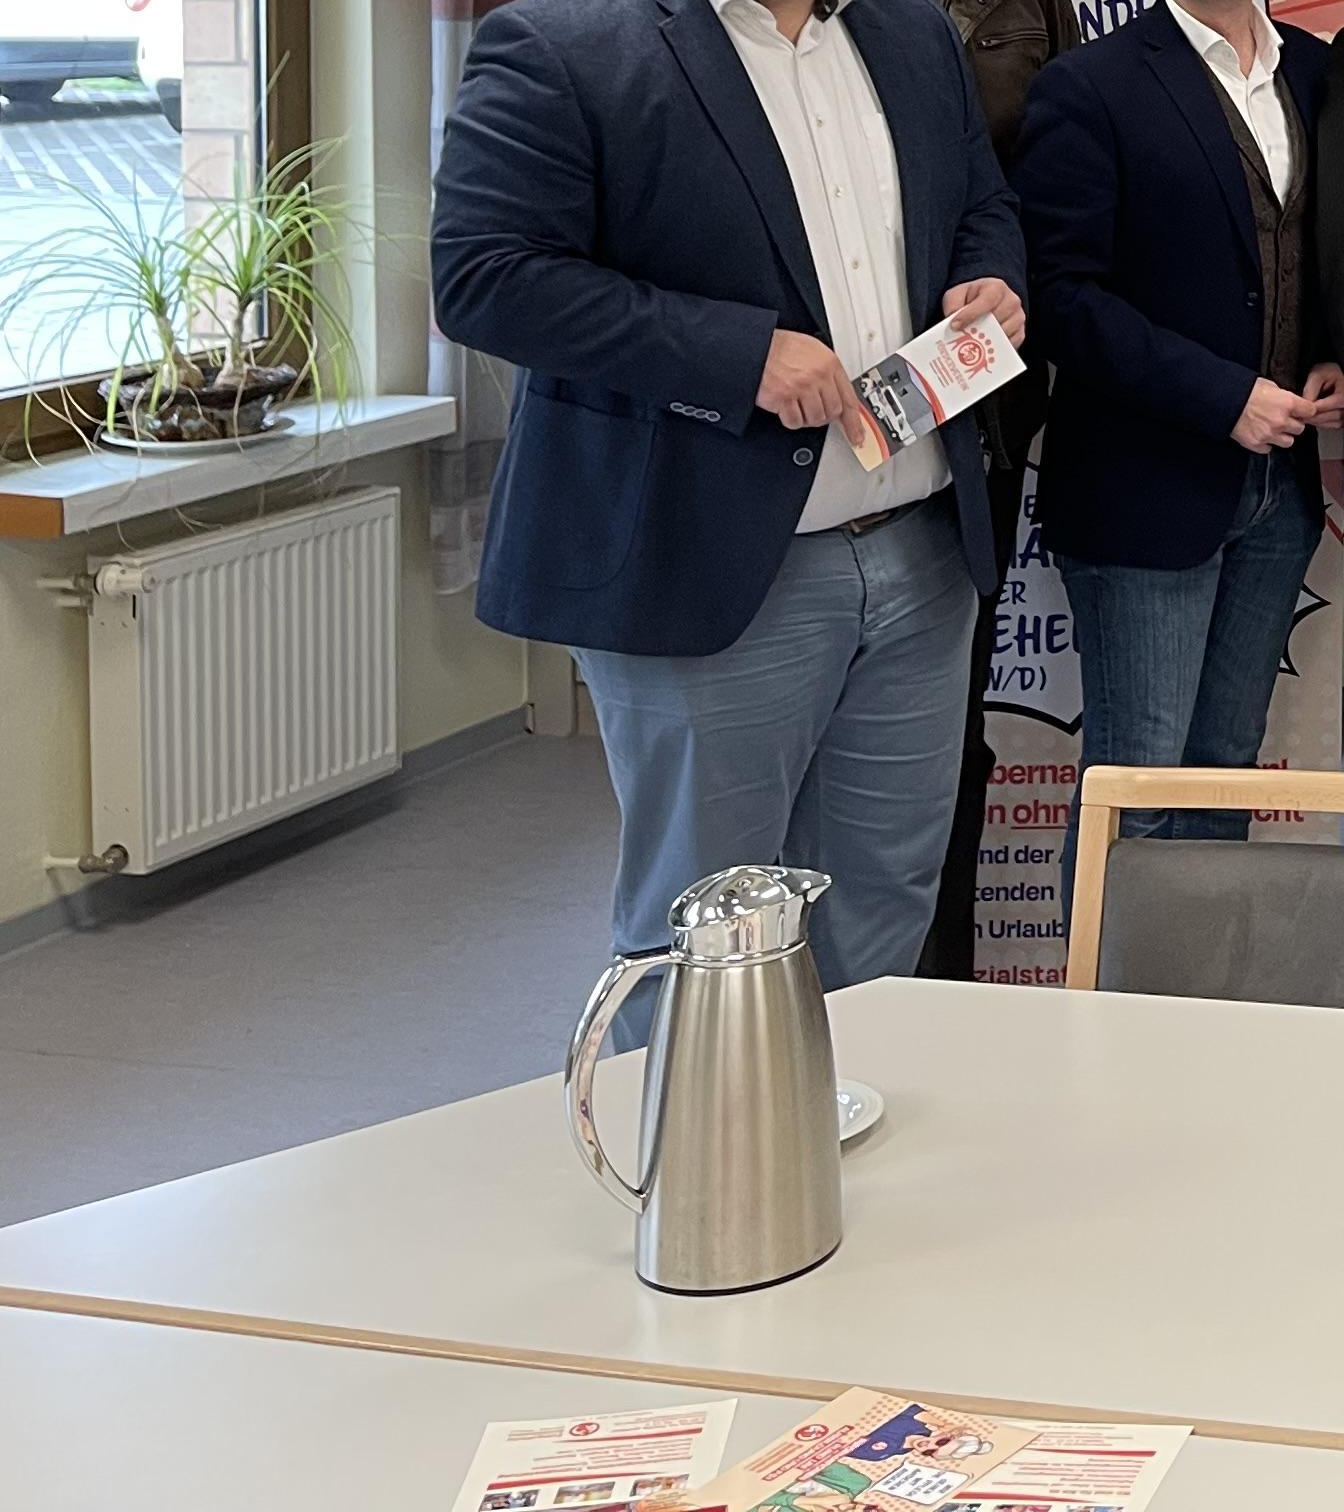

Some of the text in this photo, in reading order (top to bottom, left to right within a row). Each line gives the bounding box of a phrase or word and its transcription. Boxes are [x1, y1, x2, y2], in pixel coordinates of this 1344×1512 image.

[988, 763, 1077, 786] berna
[1011, 799, 1070, 826] ohn
[979, 845, 1009, 864] nd
[1014, 846, 1055, 864] der
[988, 919, 1064, 939] Urlaub
[974, 965, 1067, 985] zialsta
